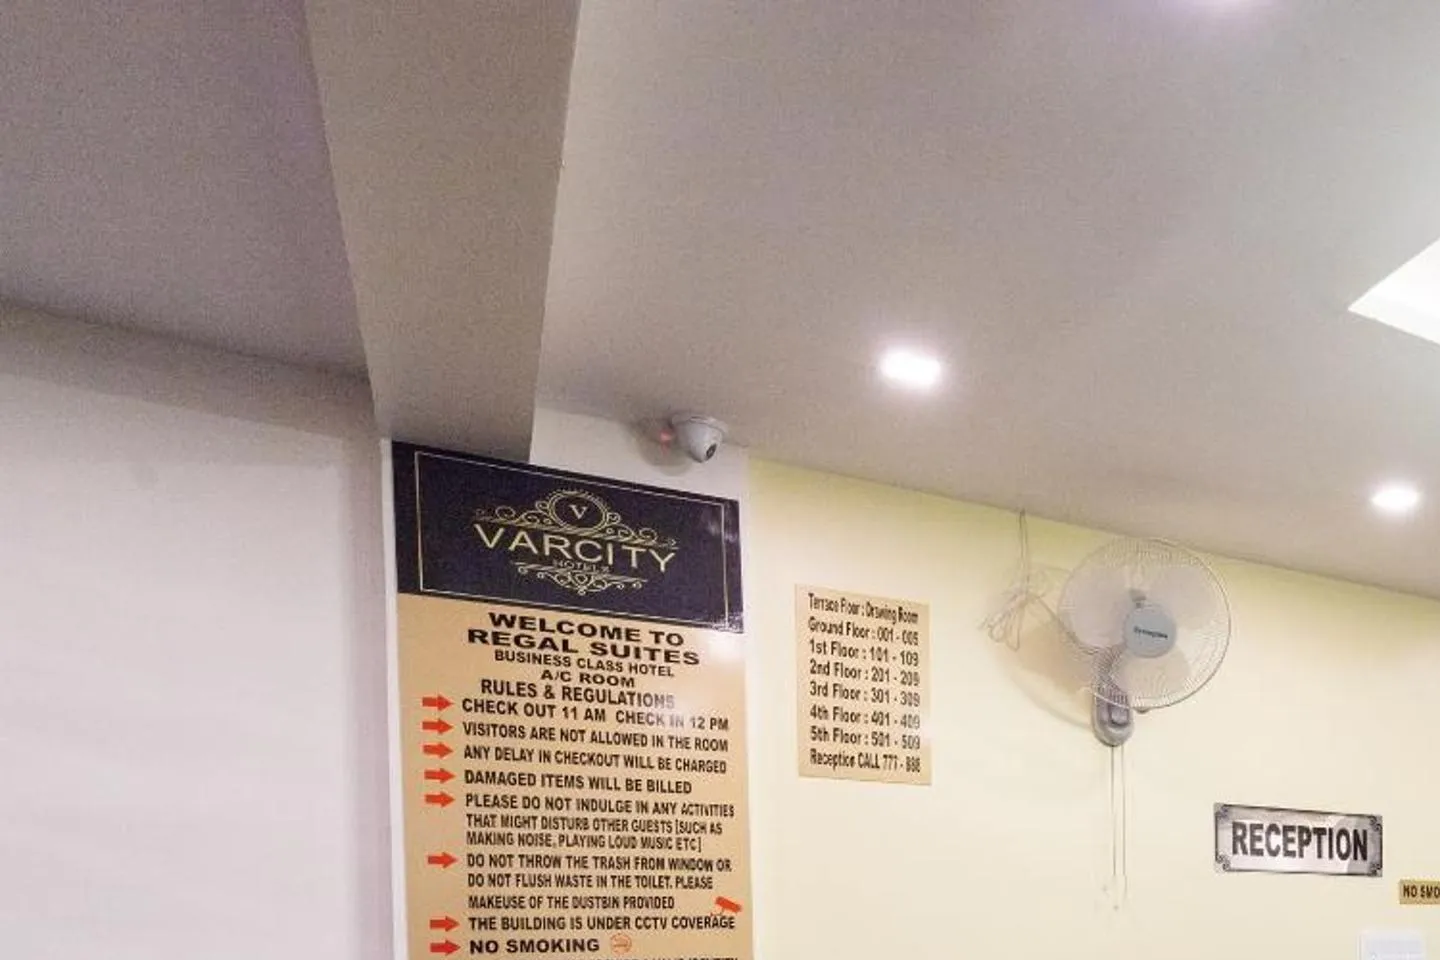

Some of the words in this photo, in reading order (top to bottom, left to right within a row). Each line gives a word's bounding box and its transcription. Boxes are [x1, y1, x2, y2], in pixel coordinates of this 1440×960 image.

[569, 504, 588, 519] V
[474, 523, 676, 573] VARCITY
[488, 612, 642, 642] WELCOME
[649, 630, 684, 647] TO
[808, 616, 843, 635] Ground
[846, 621, 870, 638] Floor
[467, 629, 578, 653] REGAL
[590, 642, 700, 665] SUITES
[810, 638, 827, 655] 1st
[831, 641, 859, 659] Floor
[870, 646, 888, 662] 101
[494, 649, 572, 667] BUSINESS
[576, 658, 623, 673] CLASS
[629, 662, 674, 677] HOTEL
[810, 658, 830, 676] 2nd
[834, 662, 861, 680] Floor
[871, 666, 890, 682] 201
[541, 670, 571, 682] A/C
[579, 673, 634, 687] ROOM
[481, 679, 537, 698] RULES
[544, 685, 555, 699] &
[562, 686, 675, 709] REGULATIONS
[810, 680, 828, 697] 3rd
[832, 683, 861, 700] Floor
[871, 687, 890, 703] 301
[462, 698, 518, 715] CHECK
[523, 702, 556, 718] OUT
[562, 706, 577, 720] 11
[584, 708, 605, 722] AM
[615, 710, 665, 726] CHECK
[669, 714, 684, 728] IN
[690, 716, 705, 730] 12
[710, 717, 729, 731] PM
[810, 704, 828, 720] 4th
[832, 706, 861, 723] Floor
[871, 710, 890, 726] 401
[463, 721, 525, 739] VISITORS
[530, 726, 556, 741] ARE
[560, 729, 585, 743] NOT
[590, 730, 648, 747] ALLOWED
[652, 735, 664, 748] IN
[668, 735, 691, 750] THE
[695, 738, 728, 752] ROOM
[810, 725, 830, 742] 5th
[832, 727, 861, 745] Floor
[871, 731, 890, 747] 501
[464, 745, 490, 760] ANY
[495, 747, 534, 762] DELAY
[539, 749, 551, 764] IN
[555, 750, 620, 767] CHECKOUT
[623, 755, 655, 769] WILL
[658, 757, 672, 771] BE
[675, 758, 727, 774] CHARGED
[465, 769, 536, 786] DAMAGED
[541, 774, 584, 789] ITEMS
[589, 776, 620, 790] WILL
[625, 778, 642, 792] BE
[647, 779, 692, 794] BILLED
[466, 793, 518, 809] PLEASE
[522, 796, 540, 810] DO
[545, 797, 572, 811] NOT
[576, 798, 632, 813] INDULGE
[635, 800, 648, 813] IN
[652, 802, 676, 815] ANY
[681, 803, 735, 817] ACTIVITIES
[466, 814, 497, 828] THAT
[500, 814, 538, 829] MIGHT
[541, 816, 590, 830] DISTURB
[593, 818, 628, 832] OTHER
[631, 819, 673, 834] GUESTS
[710, 822, 723, 836] AS
[466, 831, 514, 845] MAKING
[558, 834, 605, 848] PLAYING
[608, 835, 637, 849] LOUD
[640, 836, 673, 850] MUSIC
[1231, 821, 1369, 861] RECEPTION
[467, 853, 484, 867] DO
[489, 854, 514, 868] NOT
[518, 854, 561, 869] THROW
[565, 855, 588, 869] THE
[592, 856, 630, 870] TRASH
[635, 857, 665, 870] FROM
[668, 858, 713, 872] WINDOW
[716, 859, 732, 872] OR
[468, 873, 484, 887] DO
[488, 873, 511, 887] NOT
[515, 873, 551, 887] FLUSH
[555, 874, 592, 888] WASTE
[596, 875, 607, 888] IN
[610, 875, 631, 888] THE
[635, 875, 673, 889] TOILET.
[675, 876, 713, 890] PLEASE
[1403, 884, 1417, 898] NO
[468, 896, 526, 909] MAKEUSE
[529, 896, 543, 909] OF
[547, 896, 569, 909] THE
[572, 896, 619, 909] DUSTBIN
[623, 896, 675, 909] PROVIDED
[468, 917, 496, 930] THE
[501, 917, 566, 930] BUILDING
[570, 917, 582, 930] IS
[587, 916, 631, 930] UNDER
[635, 916, 667, 930] CCTV
[672, 915, 736, 930] COVERAGE
[470, 940, 498, 954] NO
[506, 939, 600, 953] SMOKING
